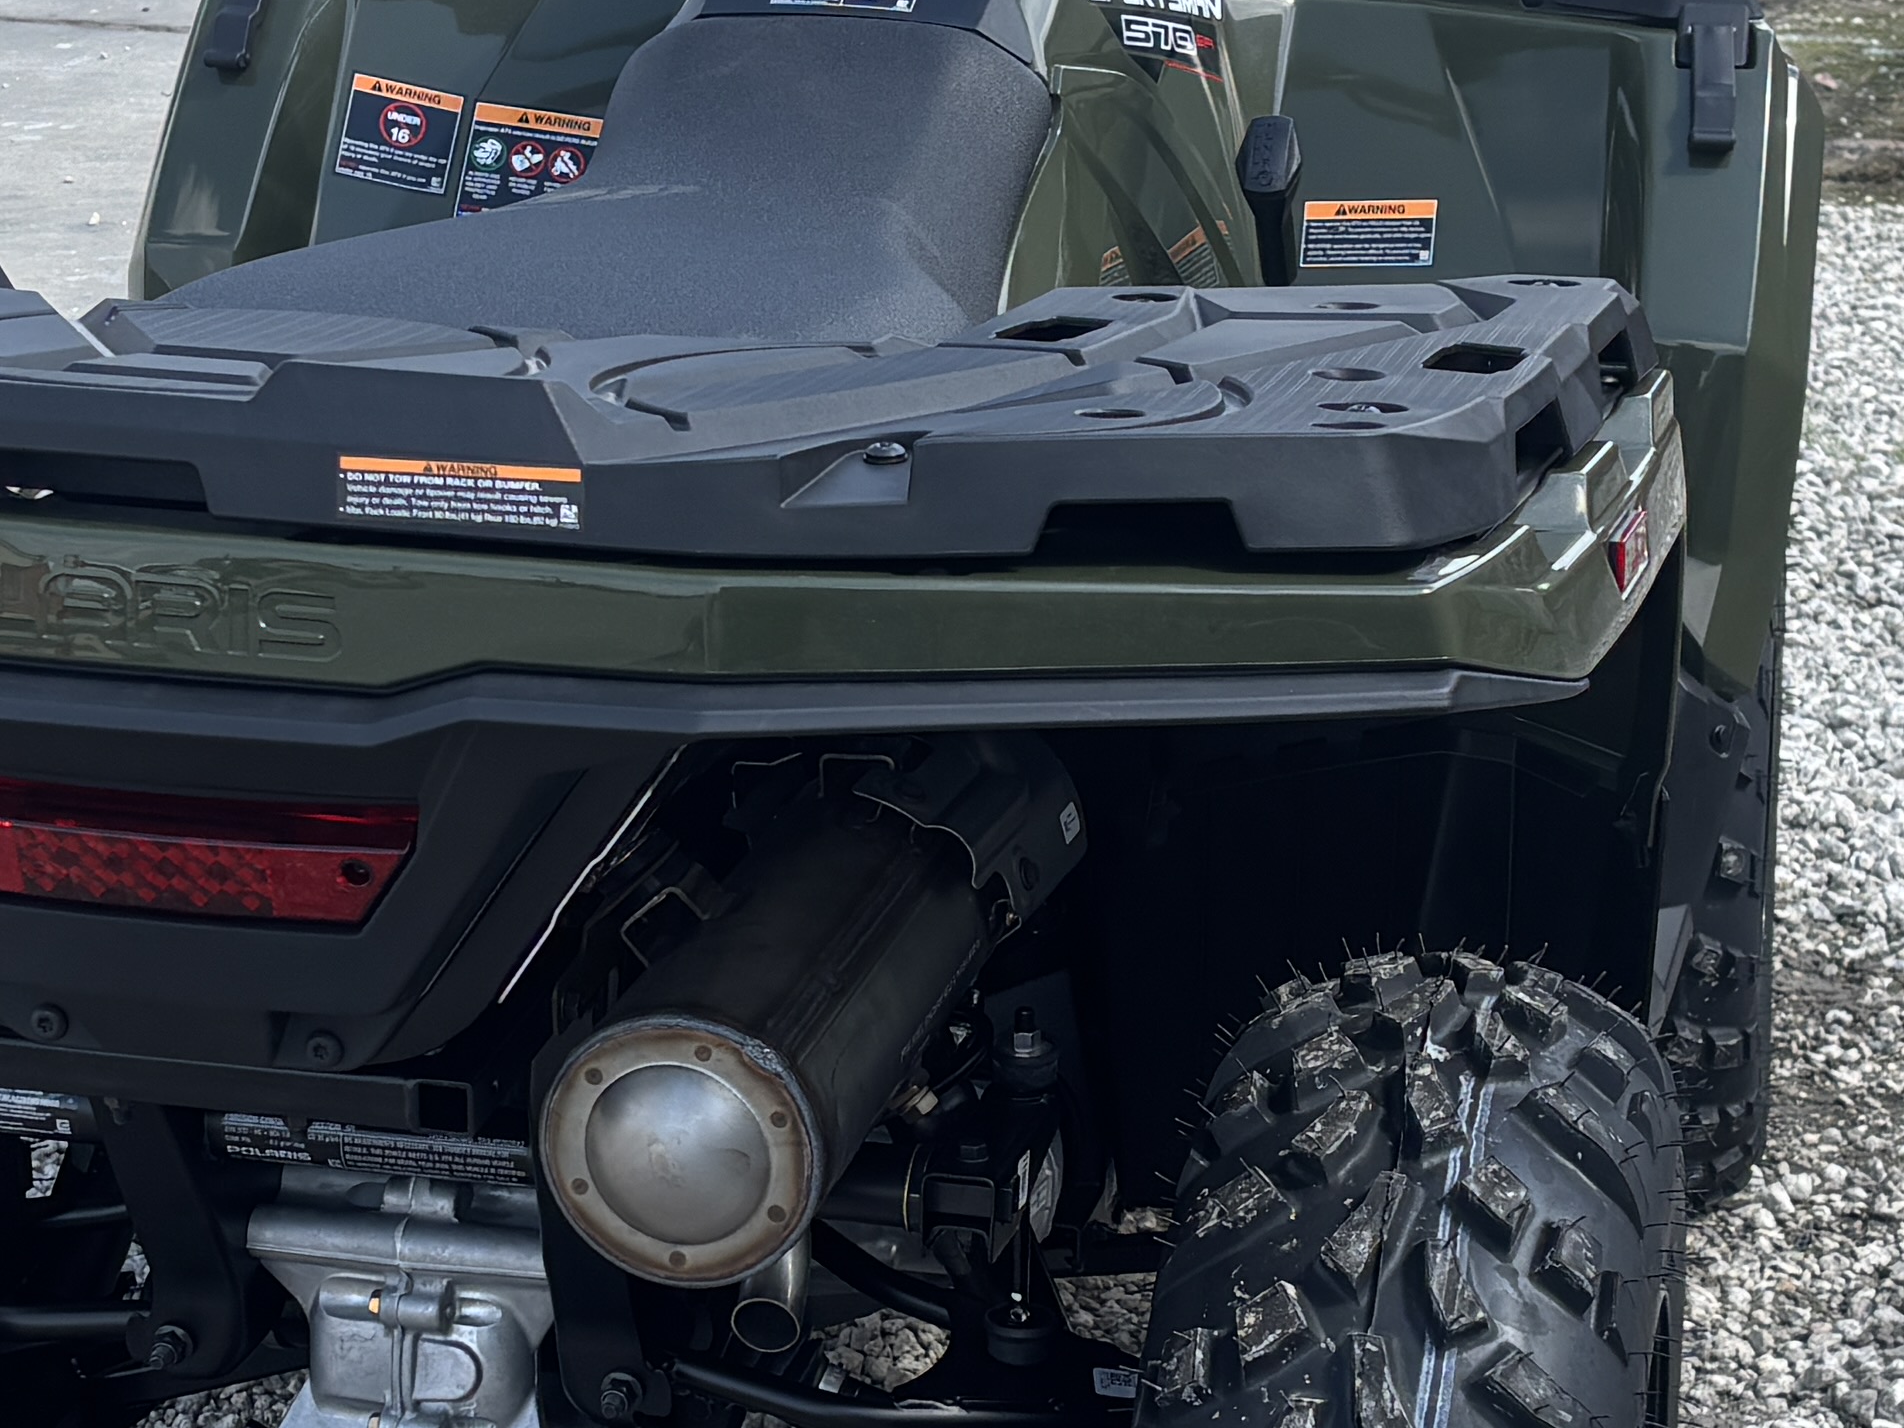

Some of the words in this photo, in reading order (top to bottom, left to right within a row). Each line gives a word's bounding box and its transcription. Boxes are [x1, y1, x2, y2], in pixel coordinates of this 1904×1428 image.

[1120, 14, 1198, 56] 570
[385, 83, 442, 106] WARNING
[387, 110, 421, 126] UNDER
[533, 113, 592, 132] WARNING
[391, 126, 411, 144] 16
[1347, 204, 1406, 216] WARNING
[436, 463, 498, 478] WARNING
[346, 472, 363, 481] DO
[363, 473, 387, 482] NOT
[387, 473, 412, 484] TOW
[413, 475, 444, 485] FROM
[445, 476, 476, 487] RACK
[477, 478, 493, 488] OR
[226, 1144, 312, 1161] POLARIS
